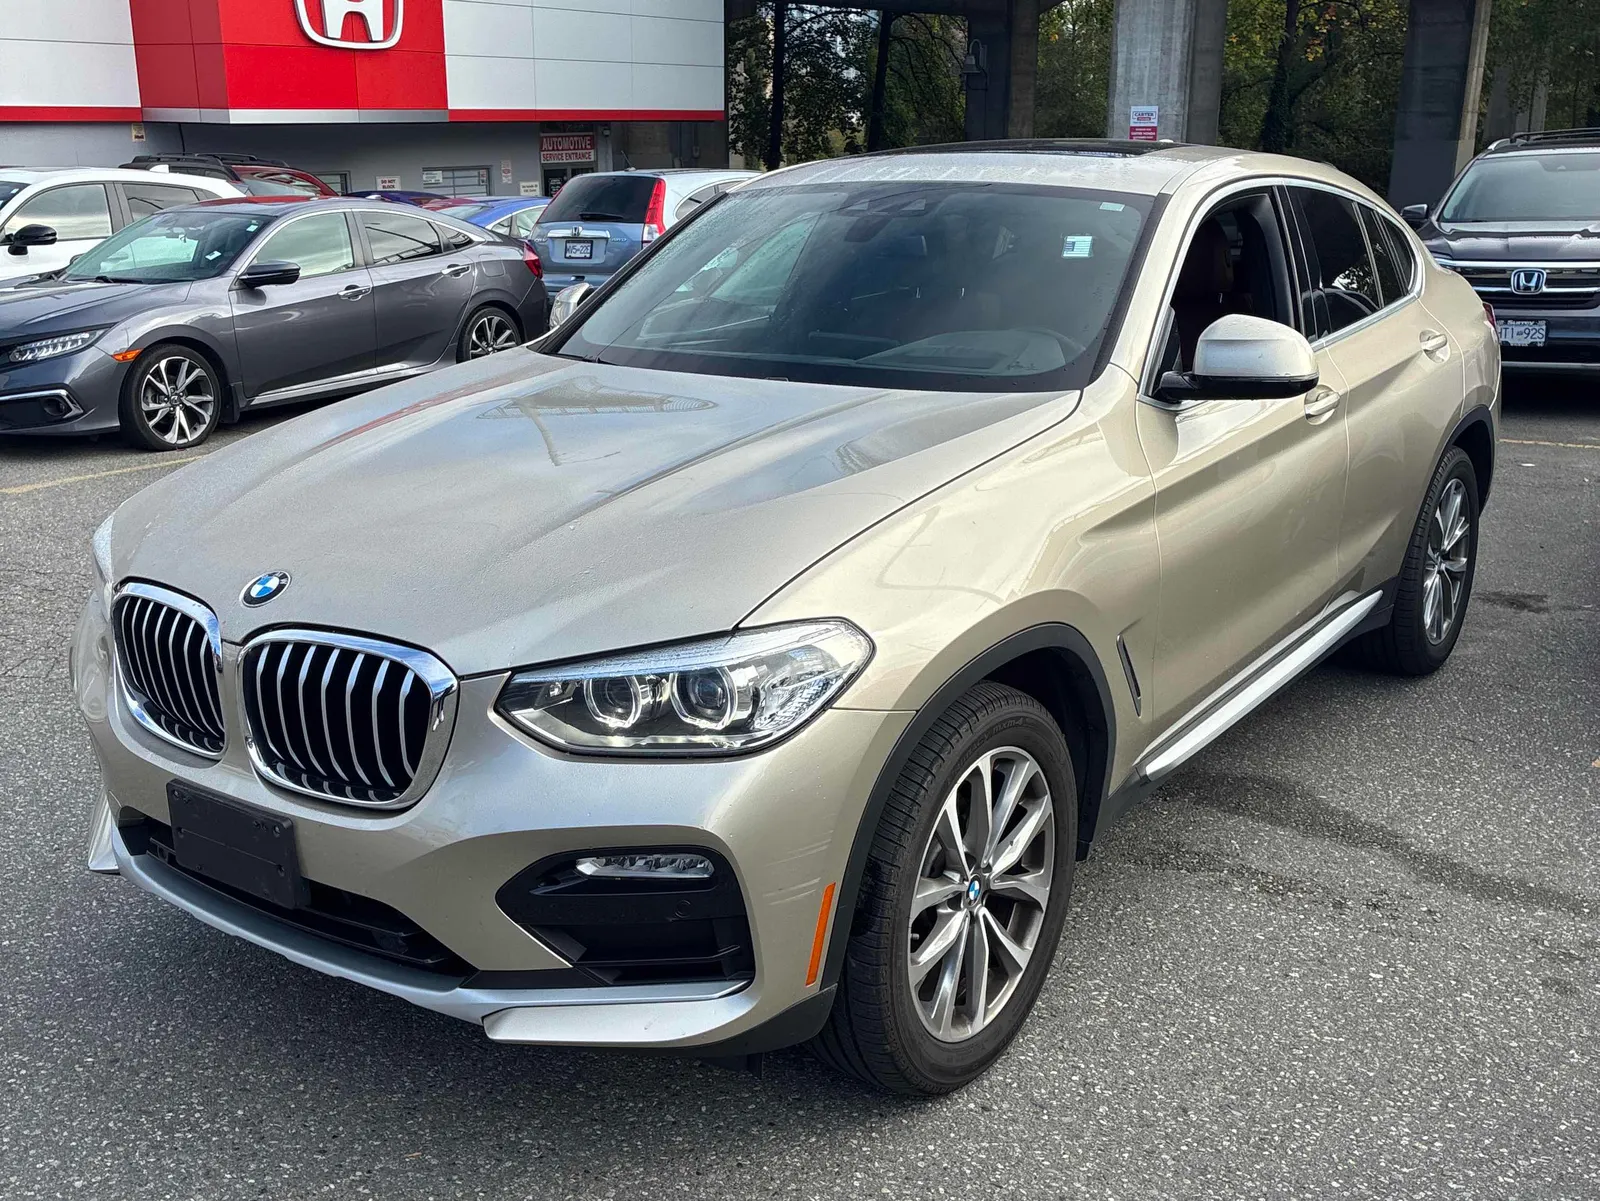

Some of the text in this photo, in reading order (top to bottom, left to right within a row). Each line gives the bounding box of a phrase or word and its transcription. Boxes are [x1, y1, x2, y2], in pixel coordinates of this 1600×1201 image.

[542, 136, 591, 150] AUTOMOTIVE
[542, 152, 592, 161] SERVICE ENTRANCE
